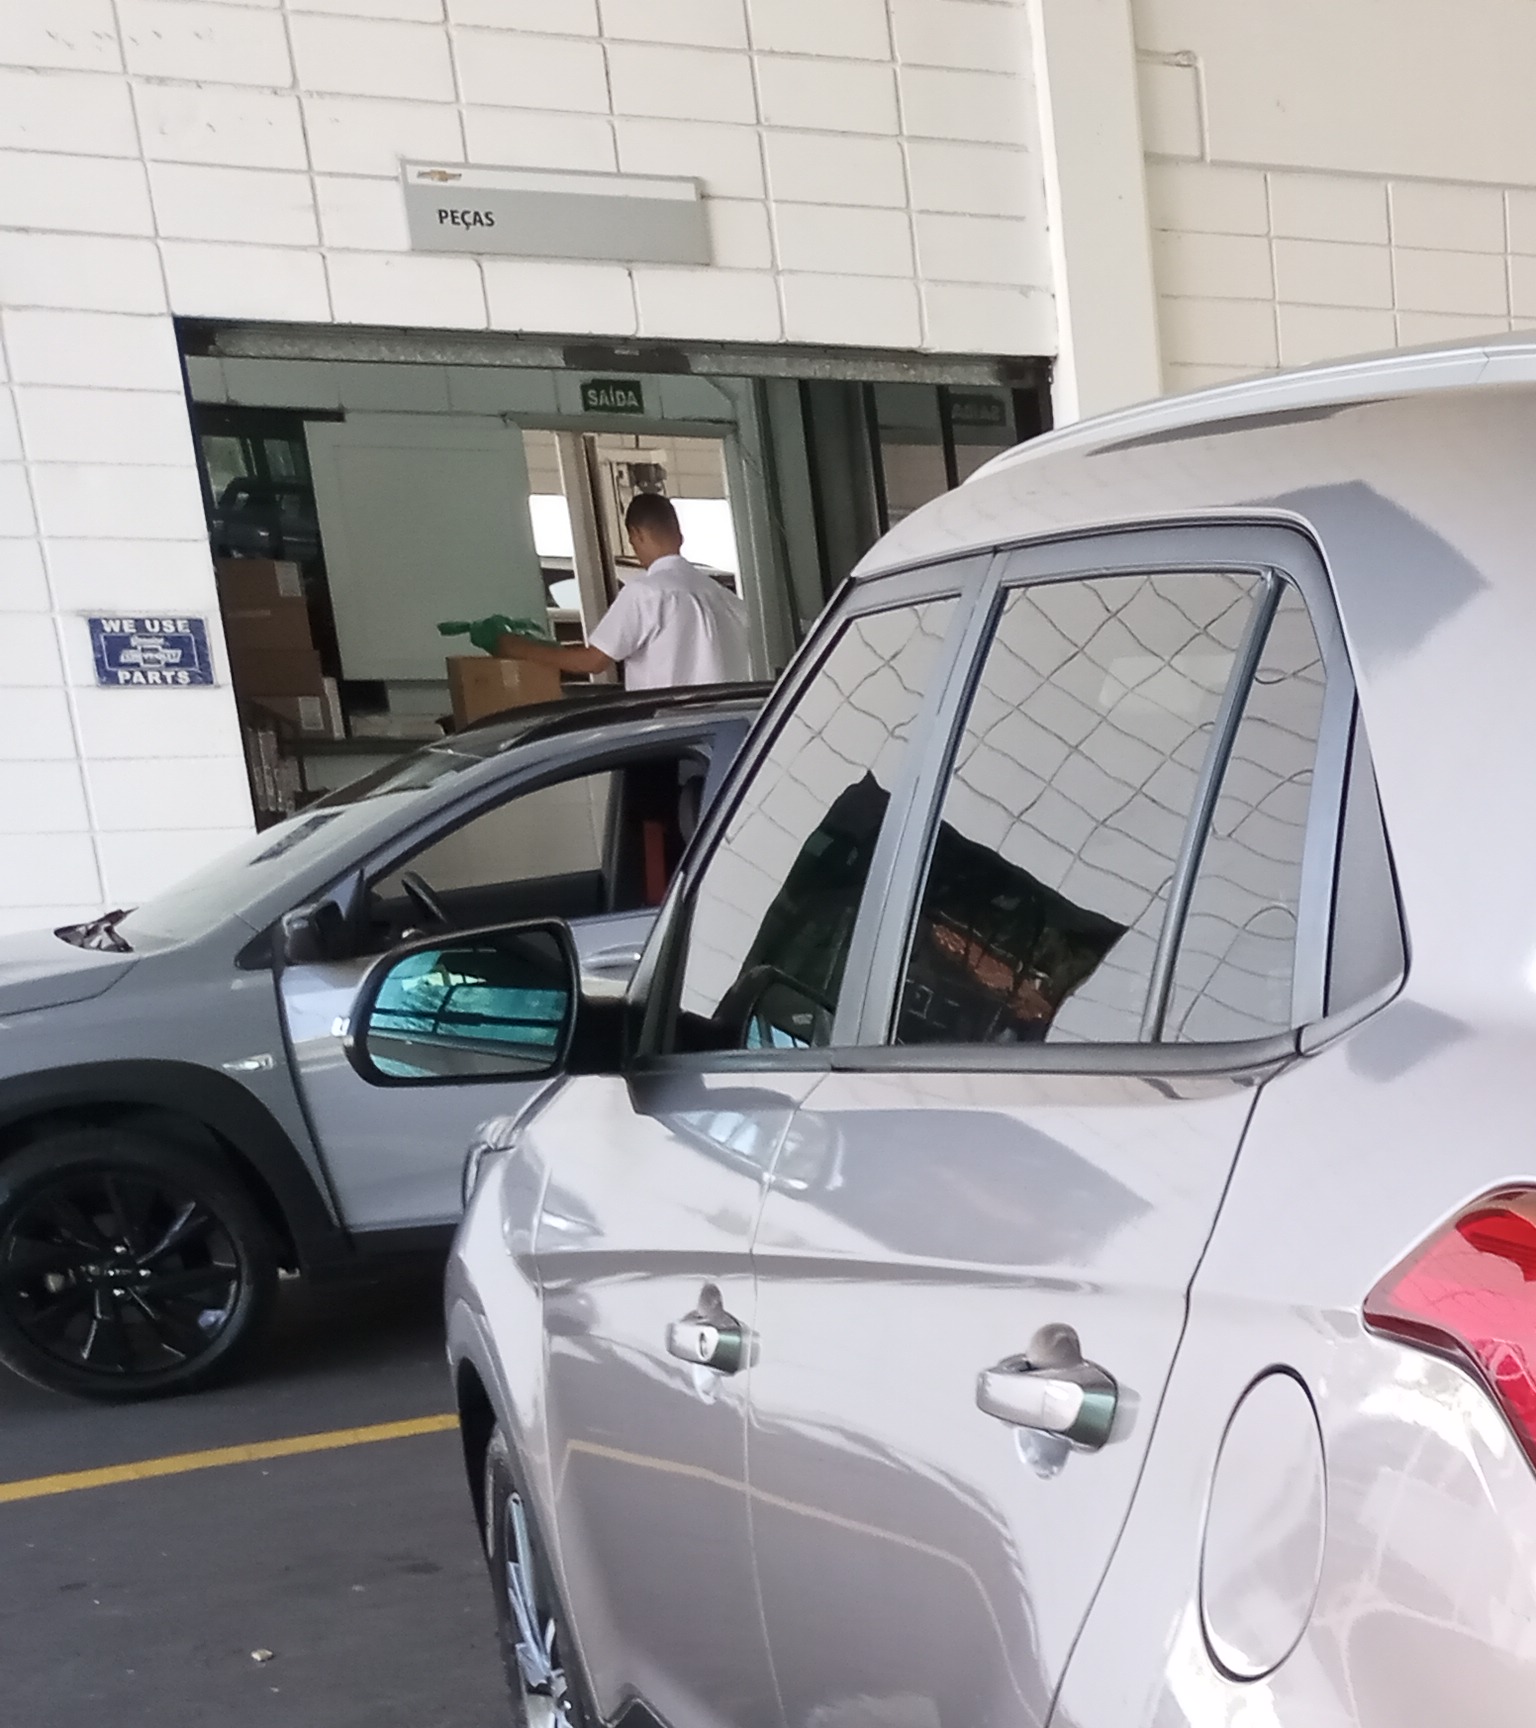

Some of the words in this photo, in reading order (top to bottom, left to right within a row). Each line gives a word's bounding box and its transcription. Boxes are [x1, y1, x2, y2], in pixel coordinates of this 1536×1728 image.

[437, 208, 496, 230] PEÇAS
[101, 619, 137, 633] WE
[145, 619, 191, 633] USE
[117, 671, 191, 685] PARTS
